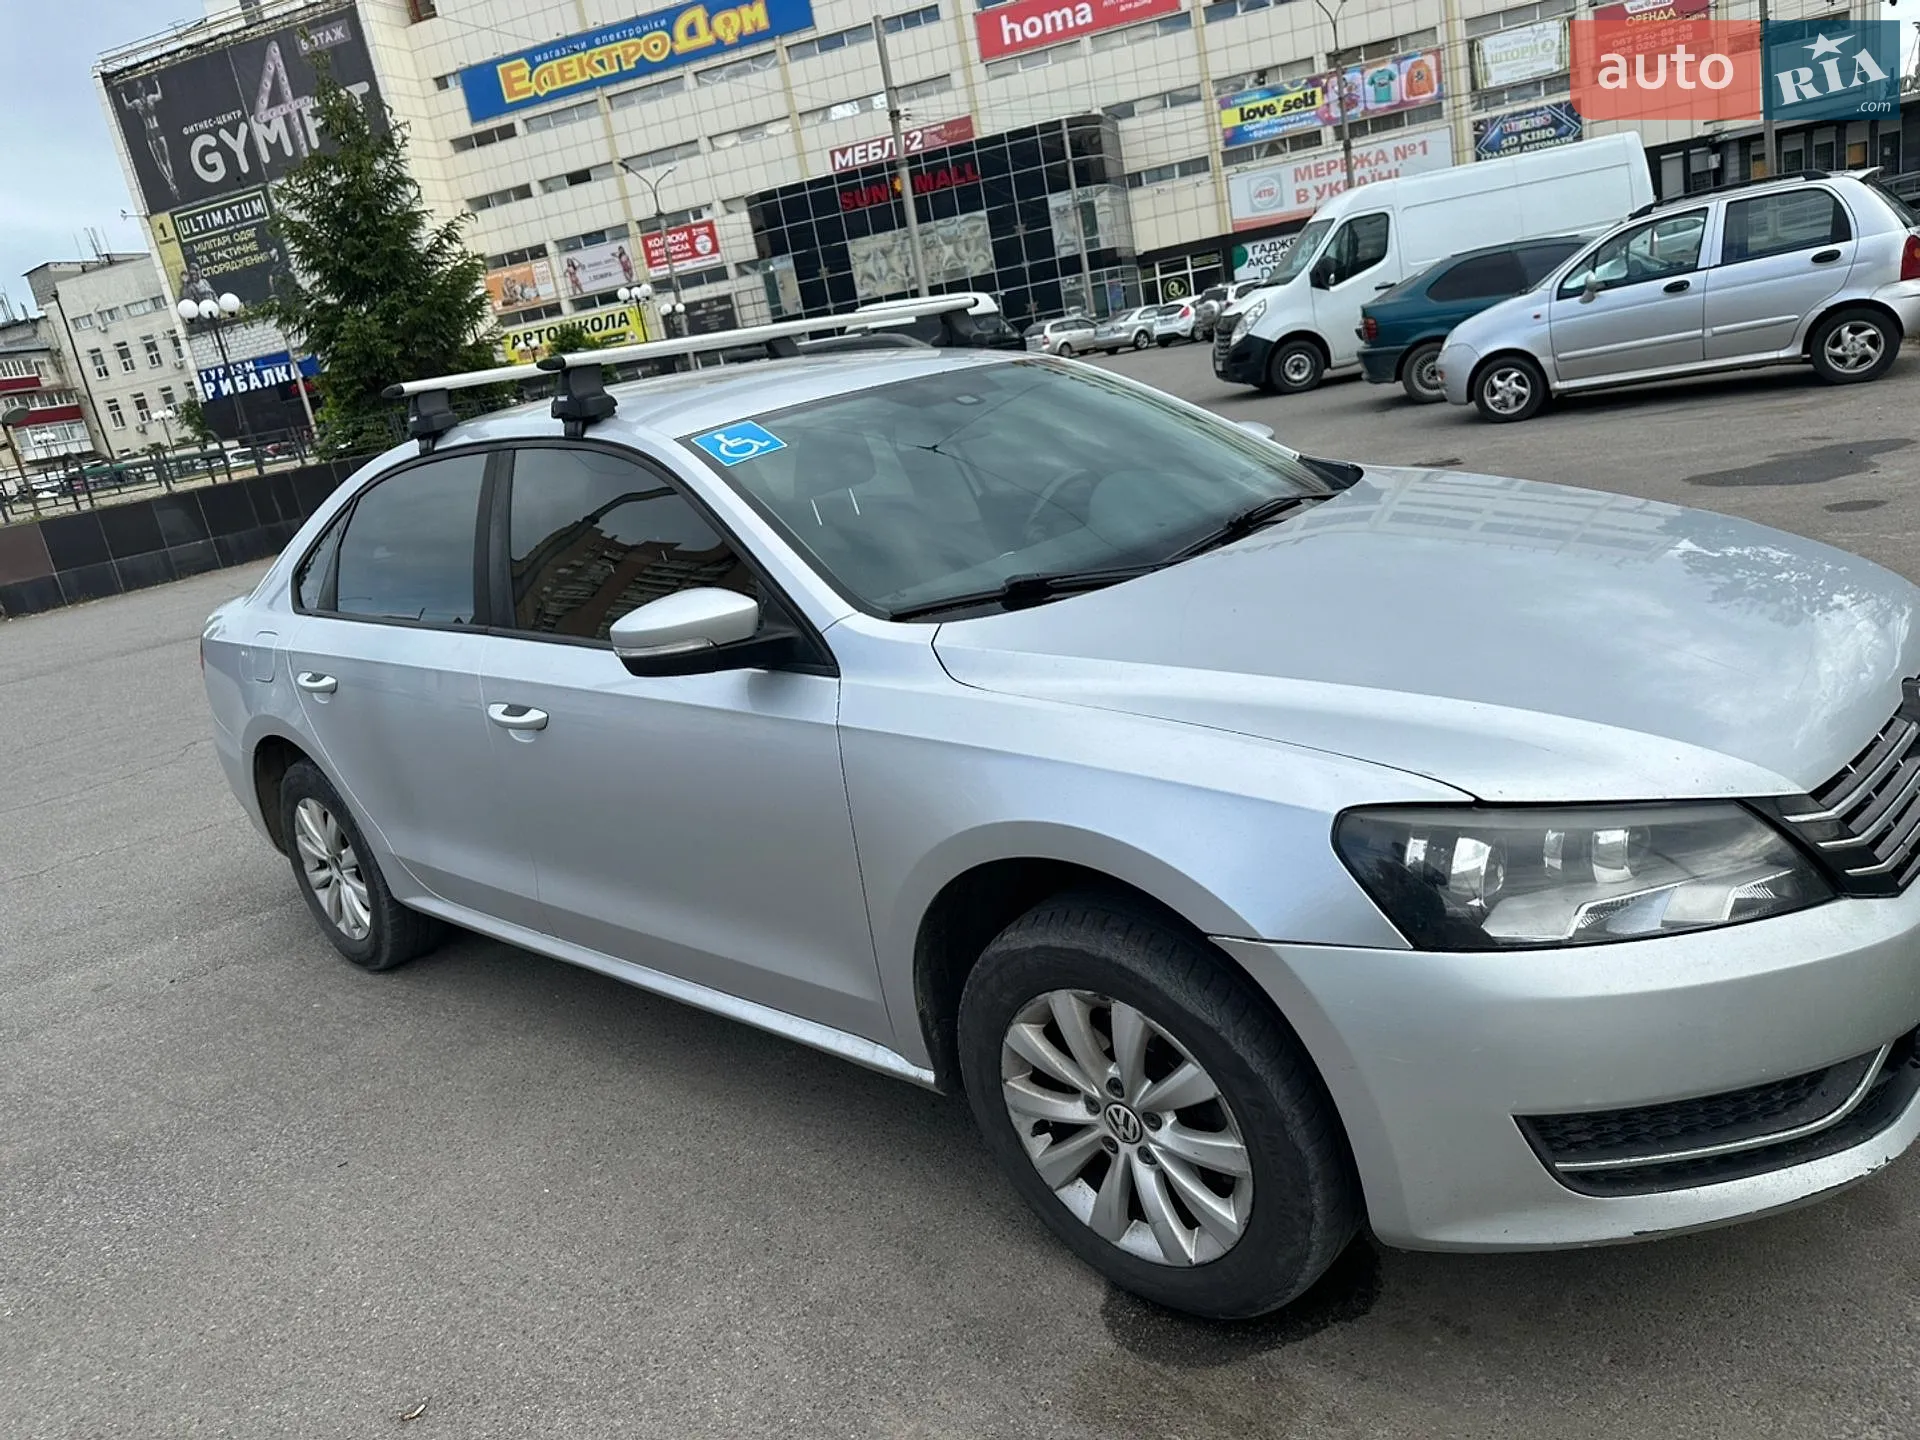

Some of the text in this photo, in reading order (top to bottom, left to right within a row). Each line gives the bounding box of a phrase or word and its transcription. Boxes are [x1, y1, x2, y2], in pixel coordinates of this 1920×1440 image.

[594, 19, 667, 45] електроніки
[1000, 2, 1093, 45] homa
[840, 163, 980, 211] SUN MALL
[1295, 188, 1311, 205] В
[158, 221, 168, 238] 1
[178, 198, 265, 236] ULTIMATUM
